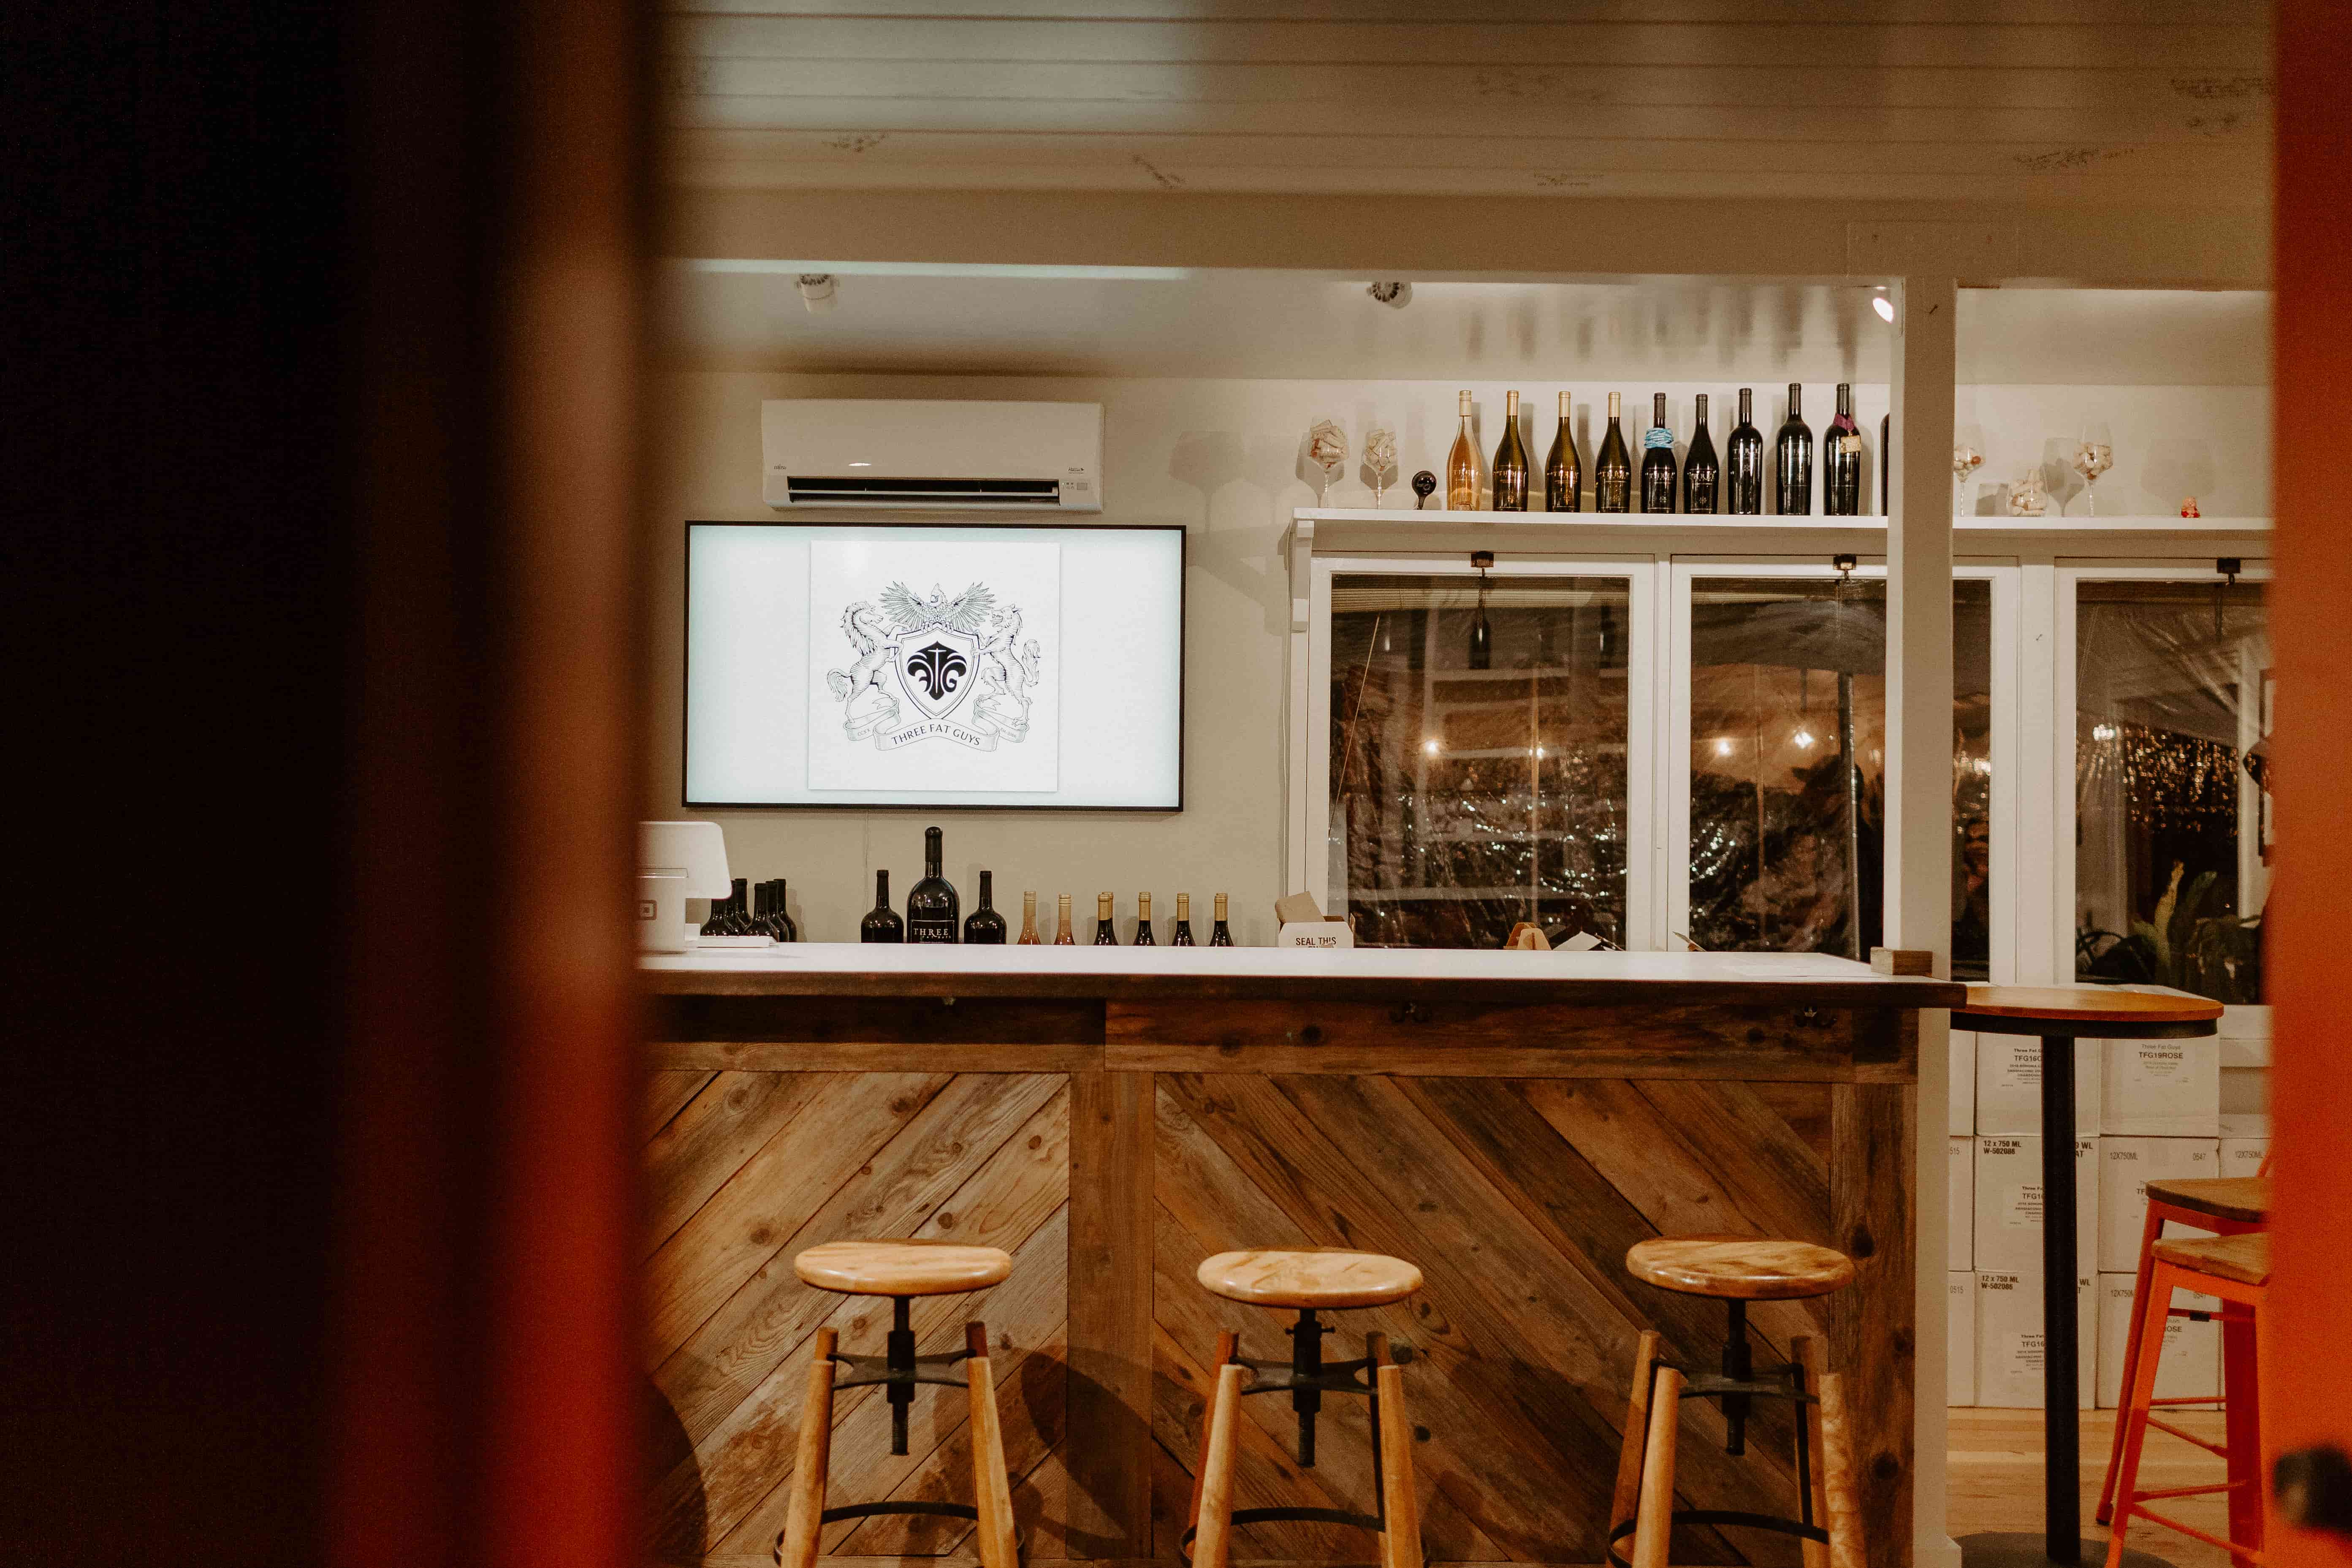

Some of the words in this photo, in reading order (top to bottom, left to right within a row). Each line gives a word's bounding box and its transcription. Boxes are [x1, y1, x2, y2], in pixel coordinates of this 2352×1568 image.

[891, 725, 927, 745] THREE
[930, 724, 951, 734] FAT
[952, 729, 982, 746] GUYS
[913, 928, 949, 937] THREE
[1296, 937, 1316, 946] SEAL
[1318, 937, 1337, 945] THIS
